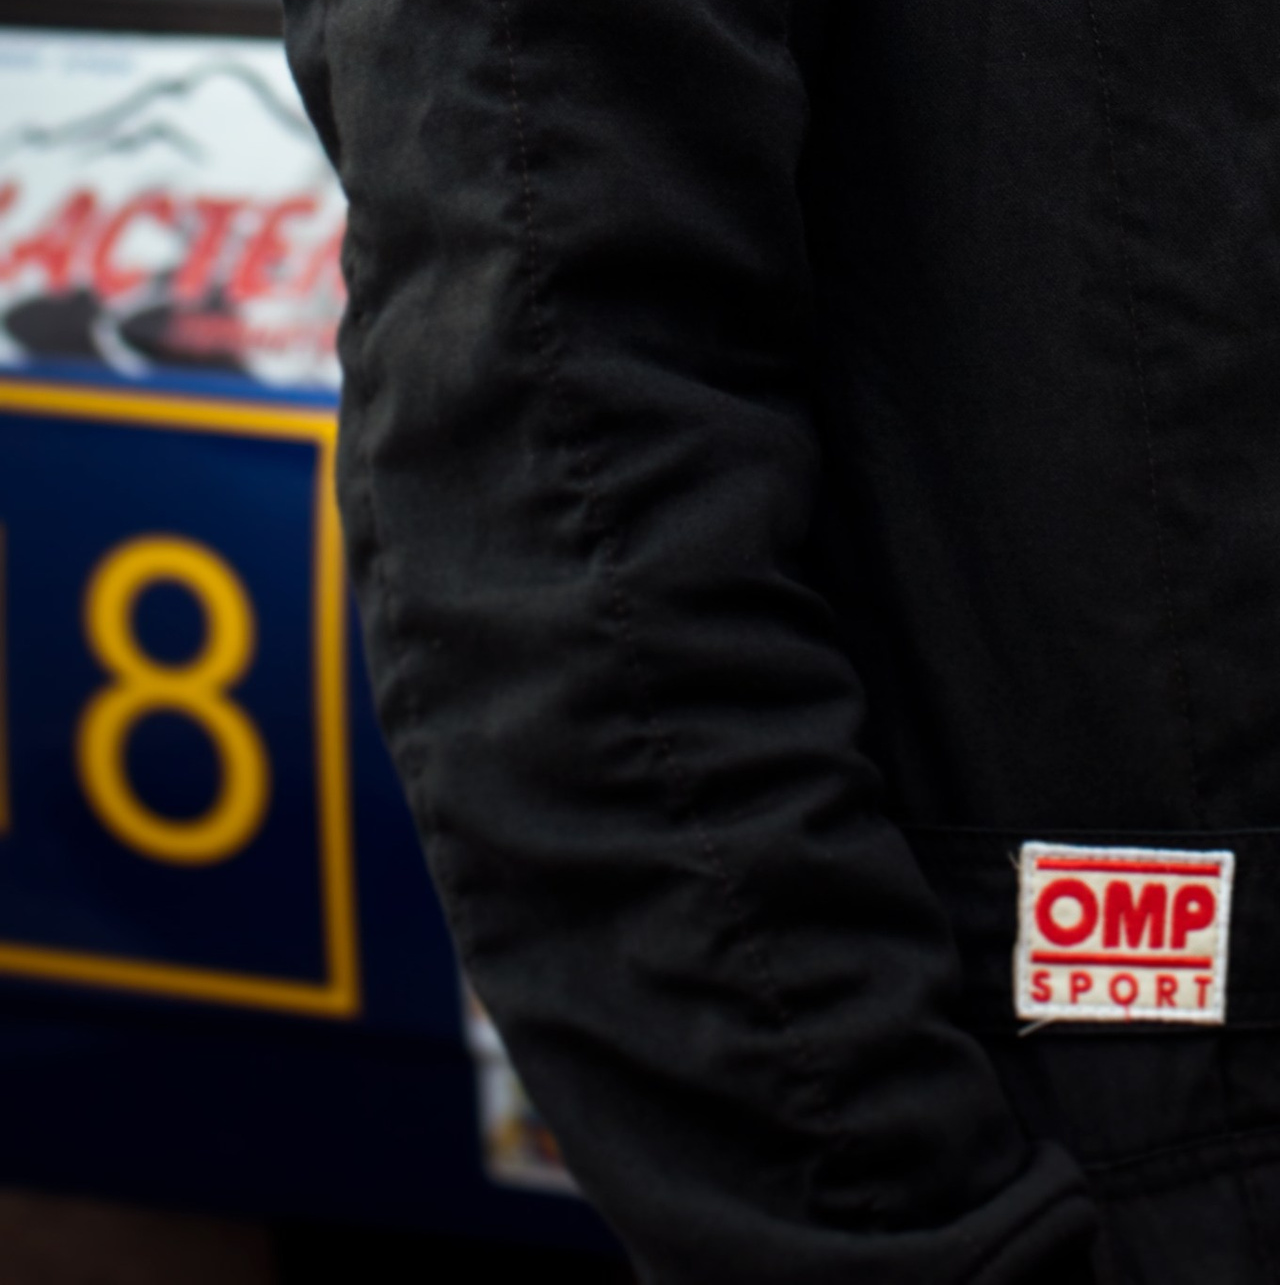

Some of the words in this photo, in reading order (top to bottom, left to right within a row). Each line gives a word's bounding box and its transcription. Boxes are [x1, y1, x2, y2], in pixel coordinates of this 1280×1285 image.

[0, 520, 272, 868] 8
[1034, 878, 1217, 950] OMP
[1030, 970, 1213, 1010] SPORT
